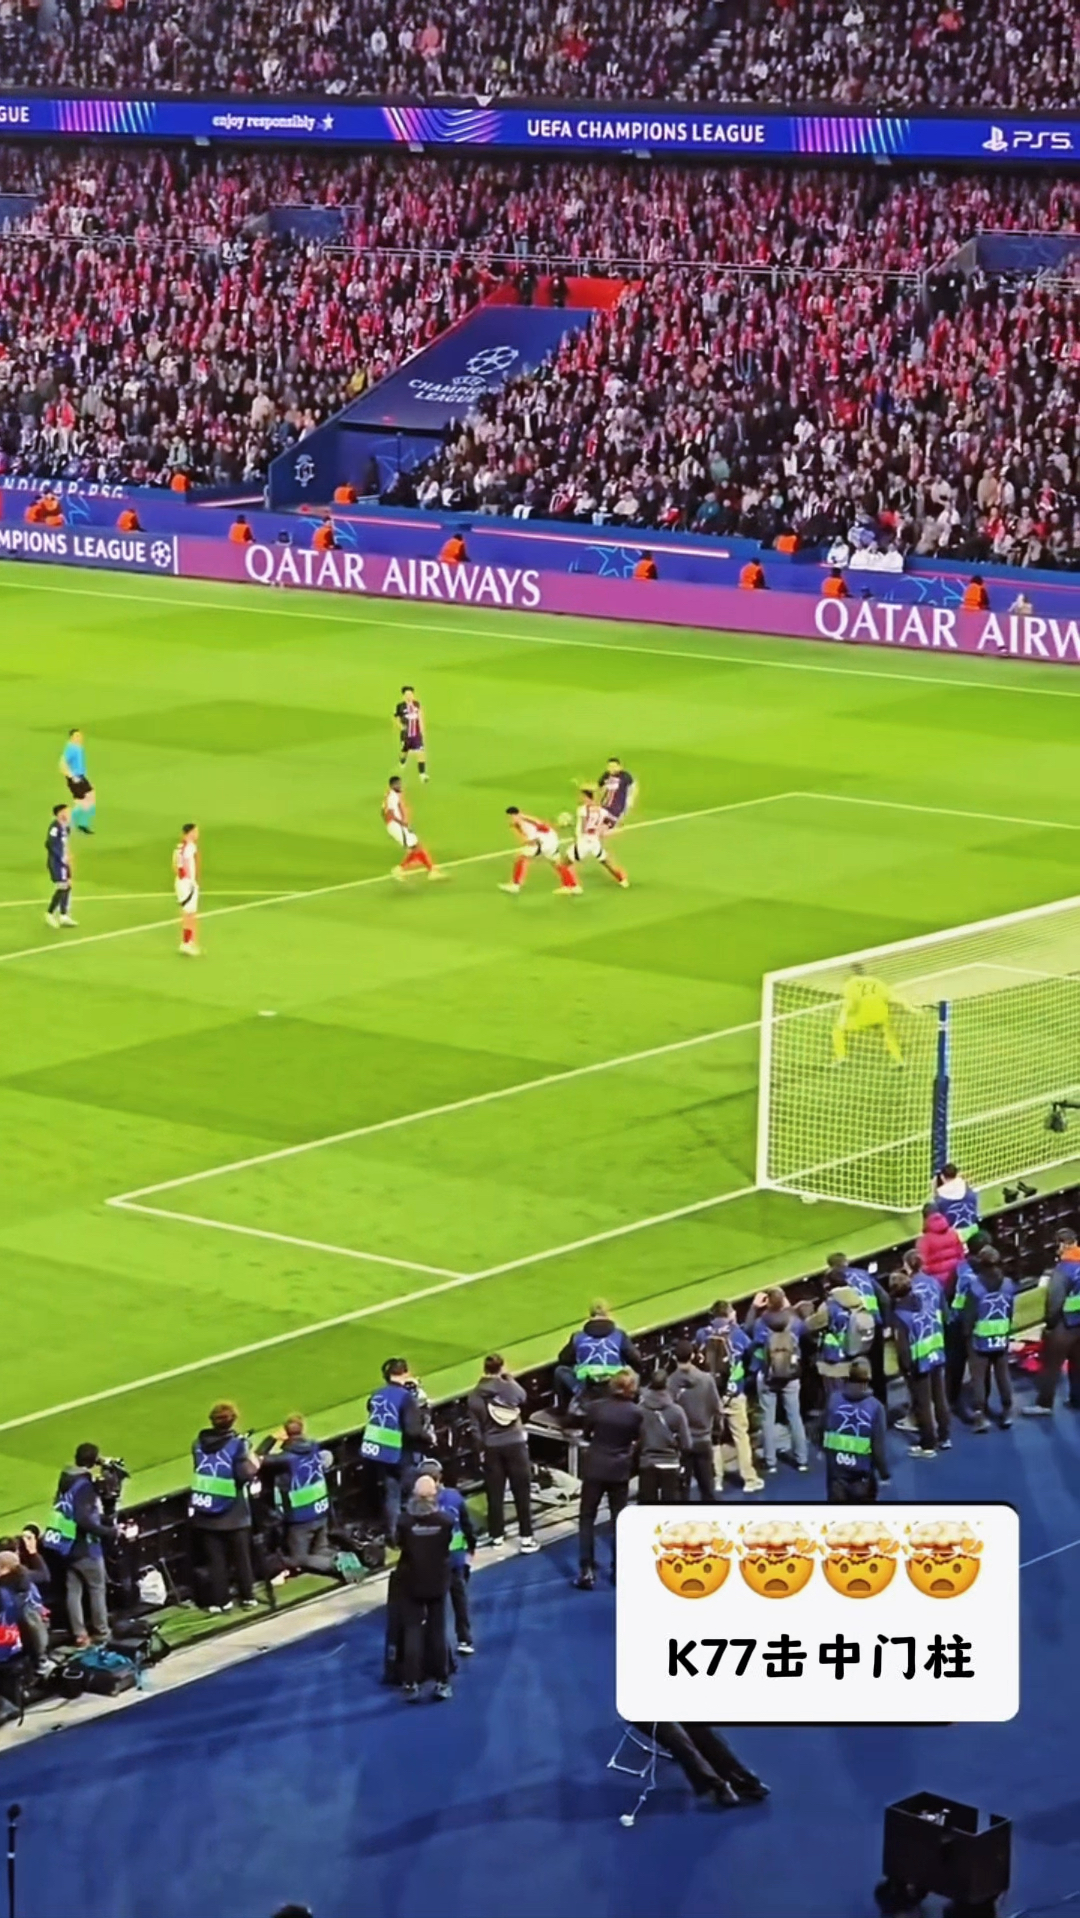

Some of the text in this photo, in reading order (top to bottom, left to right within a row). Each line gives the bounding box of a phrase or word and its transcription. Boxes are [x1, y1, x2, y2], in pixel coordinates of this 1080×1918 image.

[212, 113, 316, 131] enjoy responsibly
[527, 119, 765, 142] UEFA CHAMPIONS LEAGUE
[1013, 131, 1072, 149] PS5
[408, 379, 488, 396] CHAMPIO
[73, 536, 147, 562] LEAGUE
[245, 544, 541, 607] QATAR AIRWAYS
[815, 597, 958, 648] QATAR
